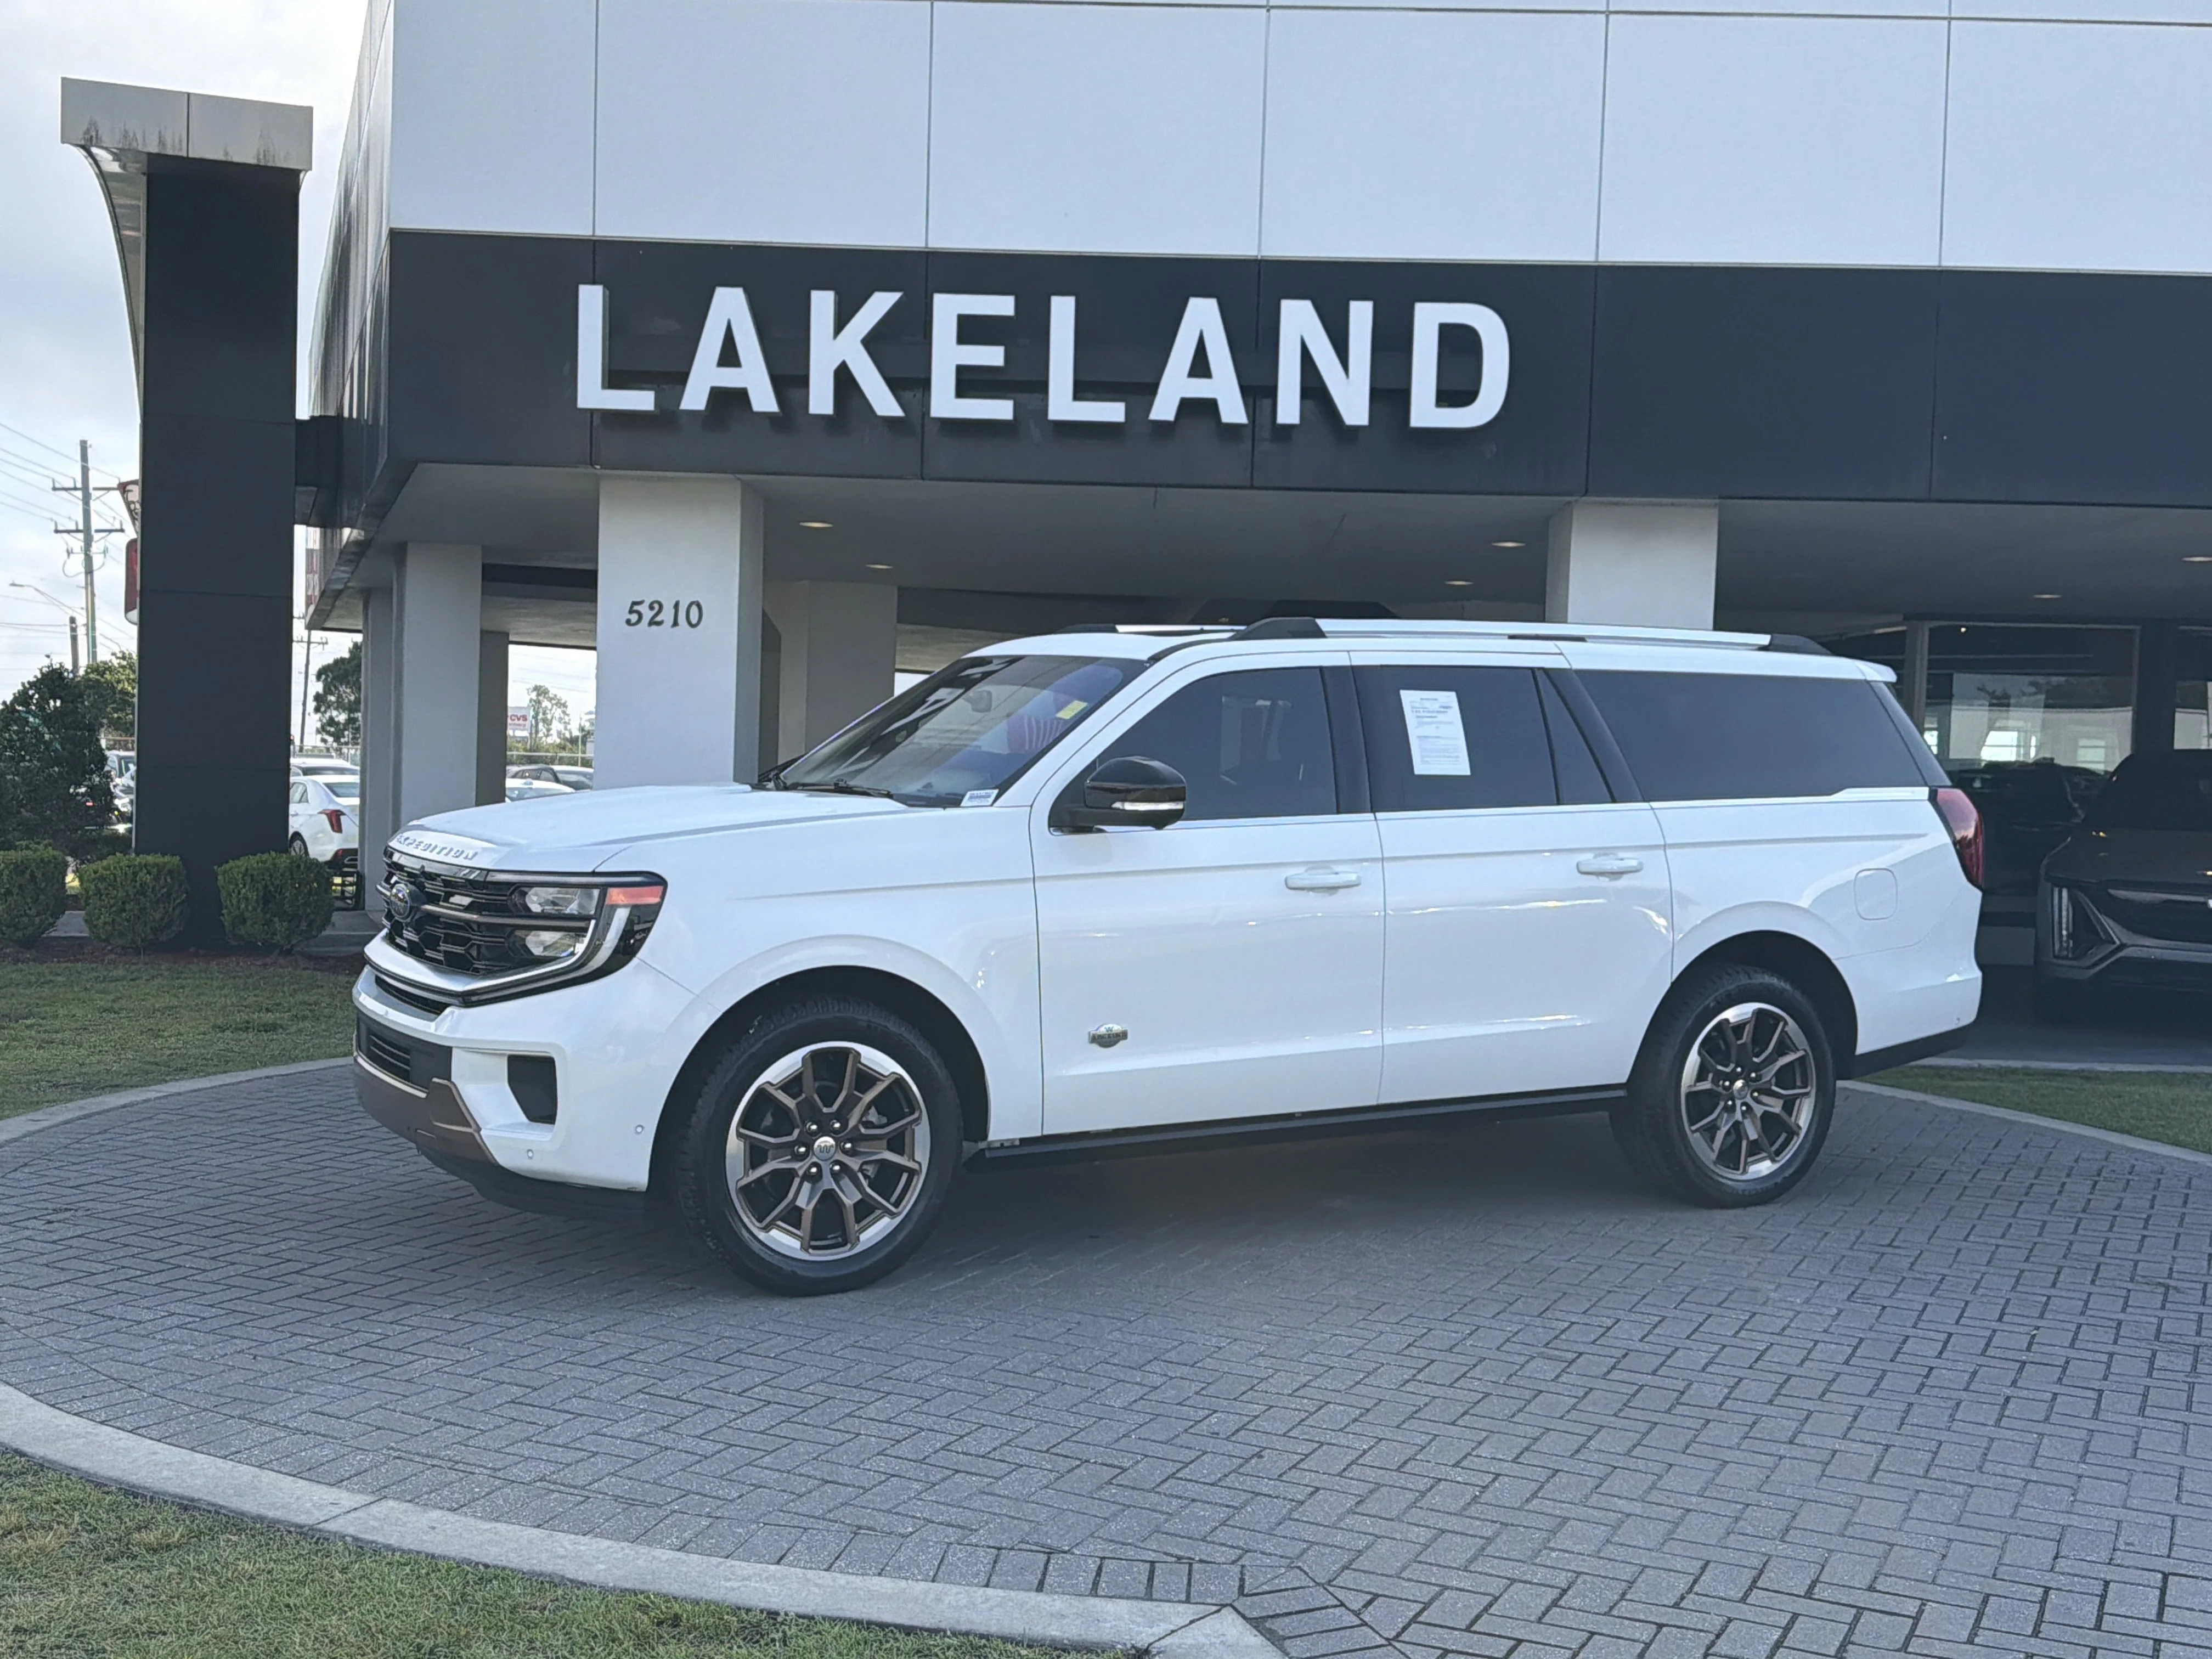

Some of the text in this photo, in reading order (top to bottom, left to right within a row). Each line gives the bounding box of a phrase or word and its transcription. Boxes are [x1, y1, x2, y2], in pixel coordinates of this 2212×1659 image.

[576, 284, 1511, 430] LAKELAND
[625, 599, 703, 629] 5210
[510, 714, 528, 722] CVS
